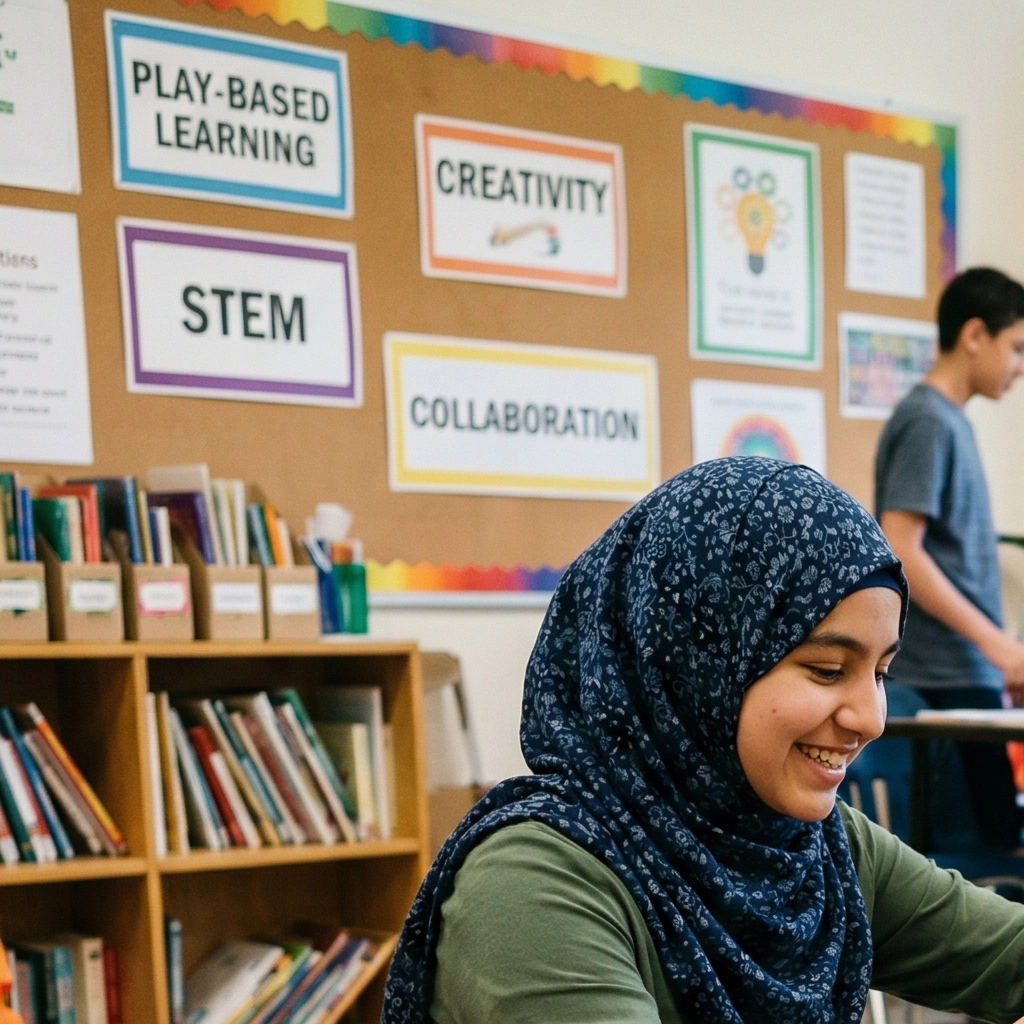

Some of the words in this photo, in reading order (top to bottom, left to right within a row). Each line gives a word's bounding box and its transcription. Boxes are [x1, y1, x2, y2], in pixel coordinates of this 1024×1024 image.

[131, 59, 331, 124] PLAY-BASED
[155, 112, 316, 169] LEARNING
[436, 158, 608, 215] CREATIVITY
[181, 284, 307, 344] STEM
[409, 395, 640, 443] COLLABORATION
